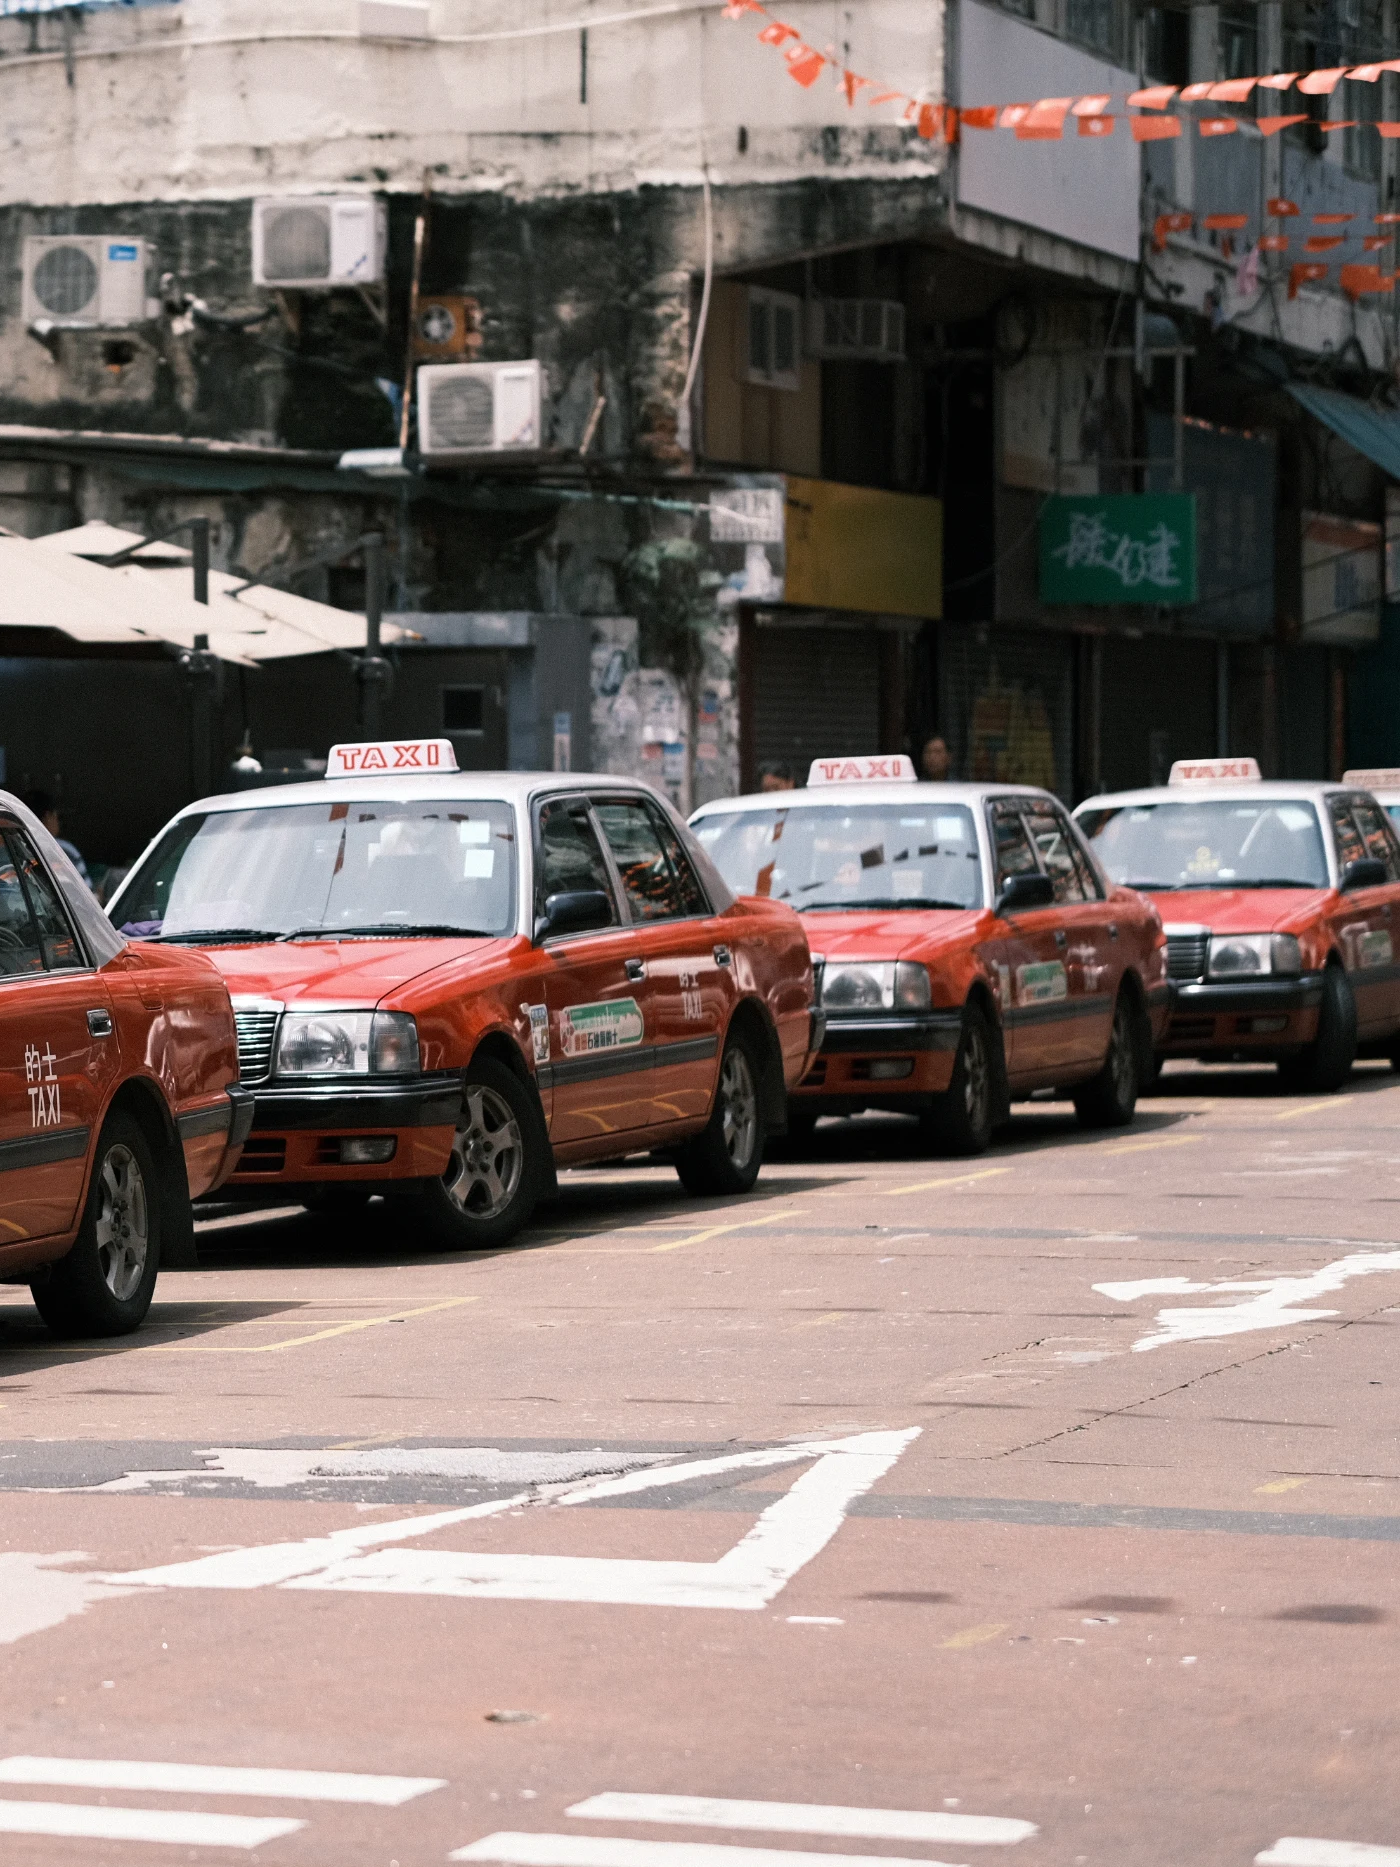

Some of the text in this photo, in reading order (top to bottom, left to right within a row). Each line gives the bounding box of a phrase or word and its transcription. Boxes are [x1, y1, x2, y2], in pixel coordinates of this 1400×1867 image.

[337, 744, 439, 770] TAXI
[819, 760, 901, 779] TAXI
[1178, 763, 1249, 779] TAXI
[681, 991, 703, 1020] TAXI
[25, 1042, 58, 1082] 的士
[27, 1084, 61, 1128] TAXI
